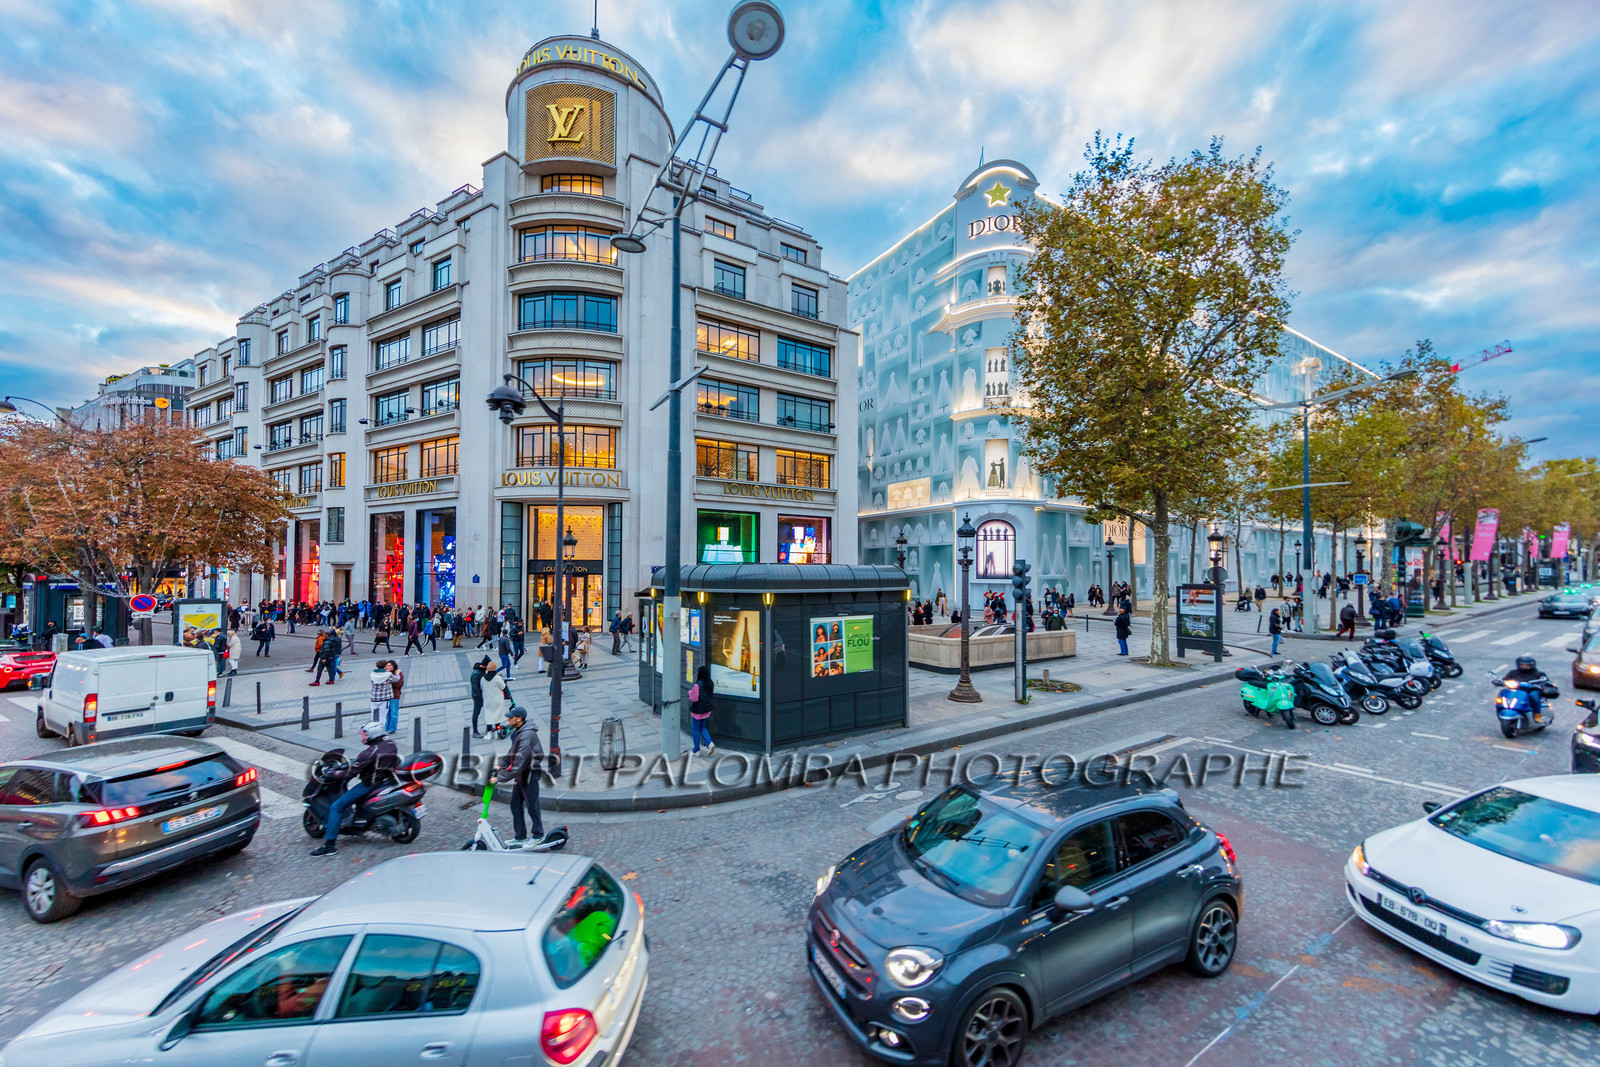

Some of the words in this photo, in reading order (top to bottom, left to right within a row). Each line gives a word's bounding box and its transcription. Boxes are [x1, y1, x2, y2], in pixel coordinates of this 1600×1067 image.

[555, 45, 638, 83] VUITTON
[968, 214, 1024, 239] DIOR
[858, 397, 874, 412] OR
[502, 472, 541, 486] LOUIS
[546, 472, 620, 487] VUITTON
[377, 485, 400, 498] LOUIS
[400, 480, 438, 495] VUITTON
[723, 483, 760, 497] LOUIS
[763, 486, 814, 501] VUITTON
[1104, 523, 1128, 537] DIOR
[847, 638, 870, 647] FLOU
